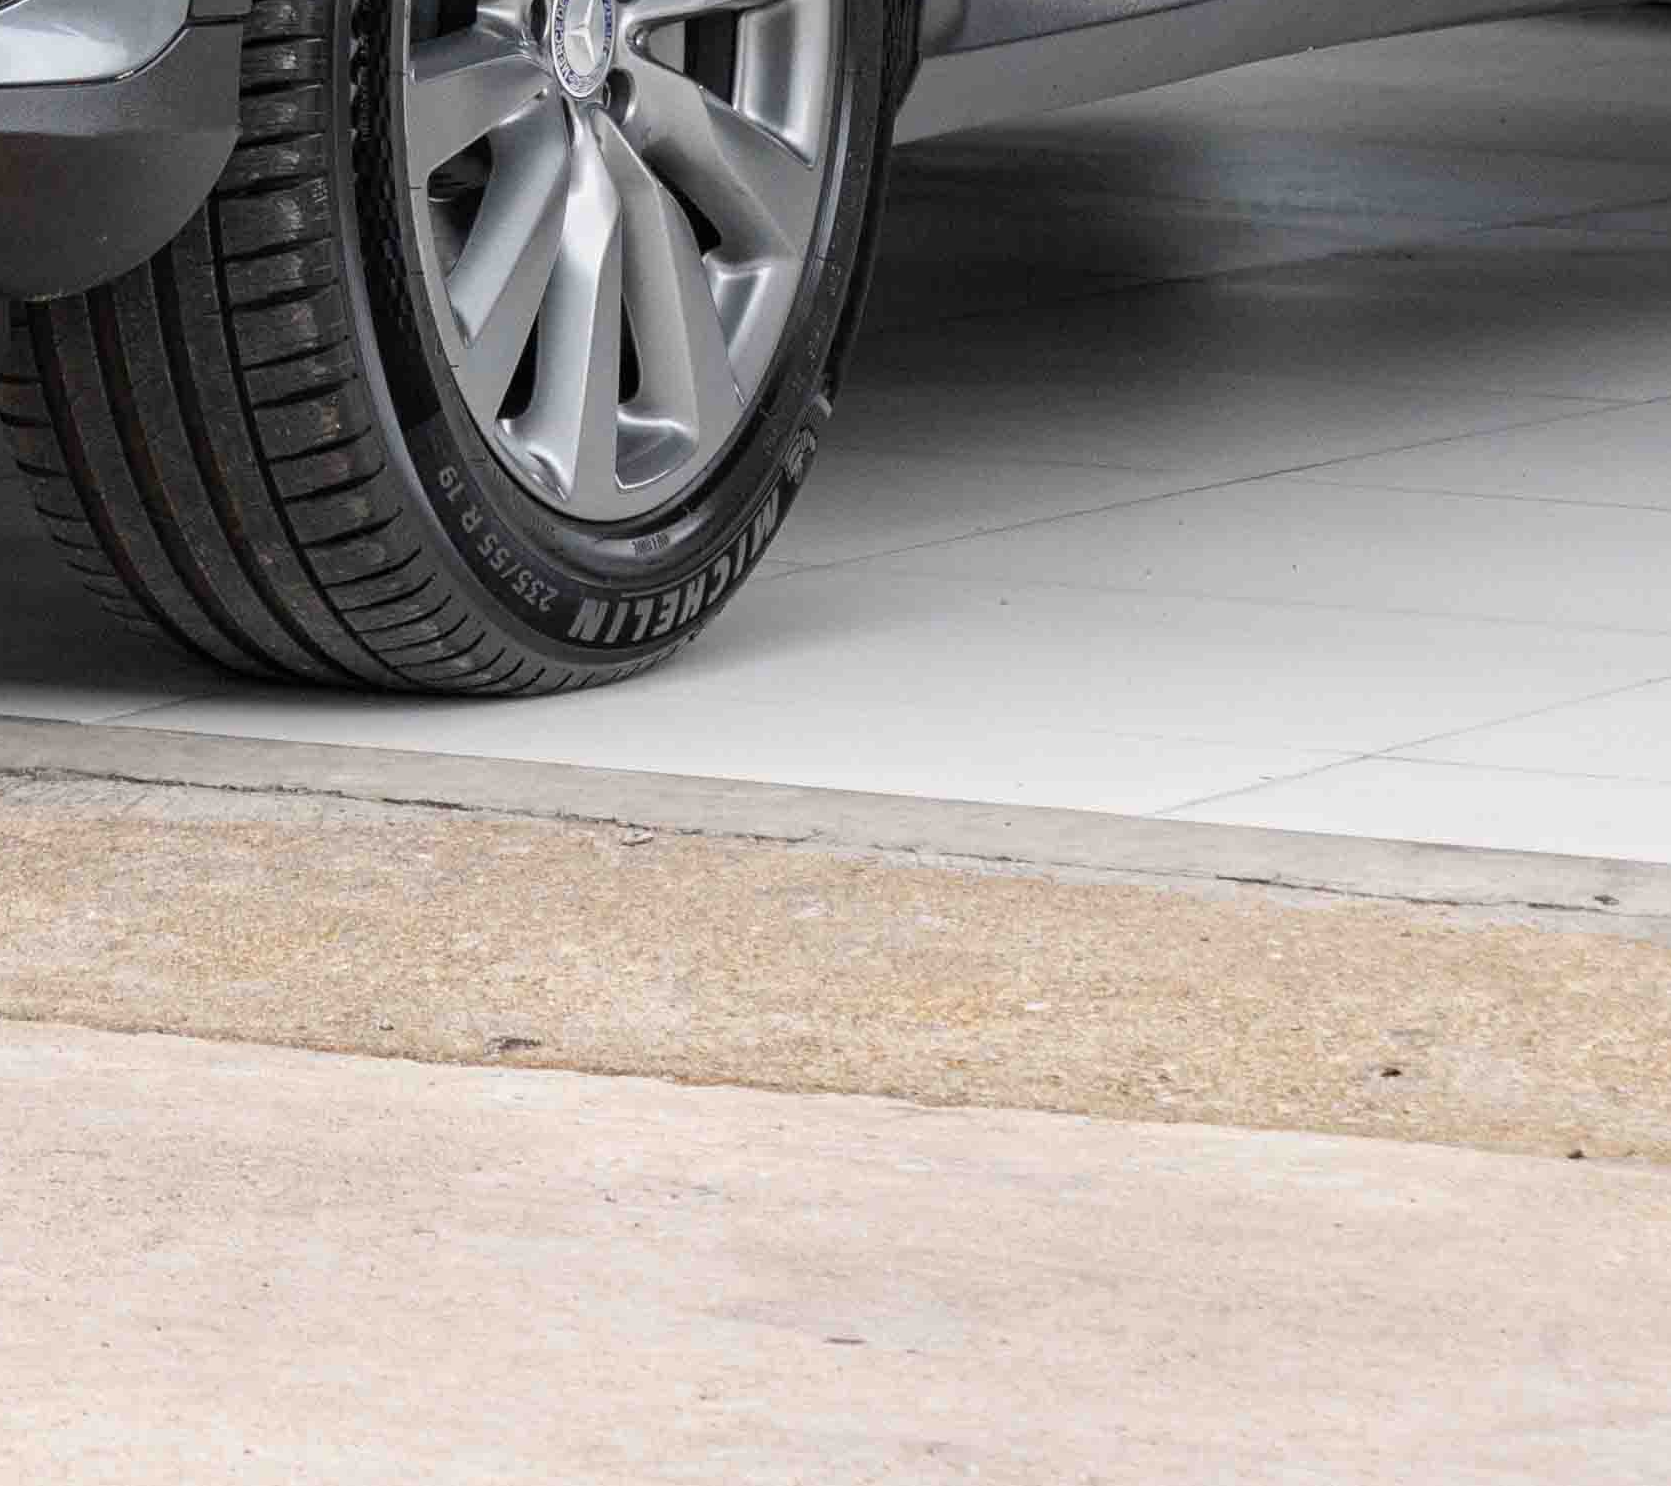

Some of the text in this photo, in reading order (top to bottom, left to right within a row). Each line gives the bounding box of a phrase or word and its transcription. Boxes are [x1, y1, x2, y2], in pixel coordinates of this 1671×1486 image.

[437, 464, 559, 612] 235/55 R 19
[566, 486, 781, 645] MICHELIN
